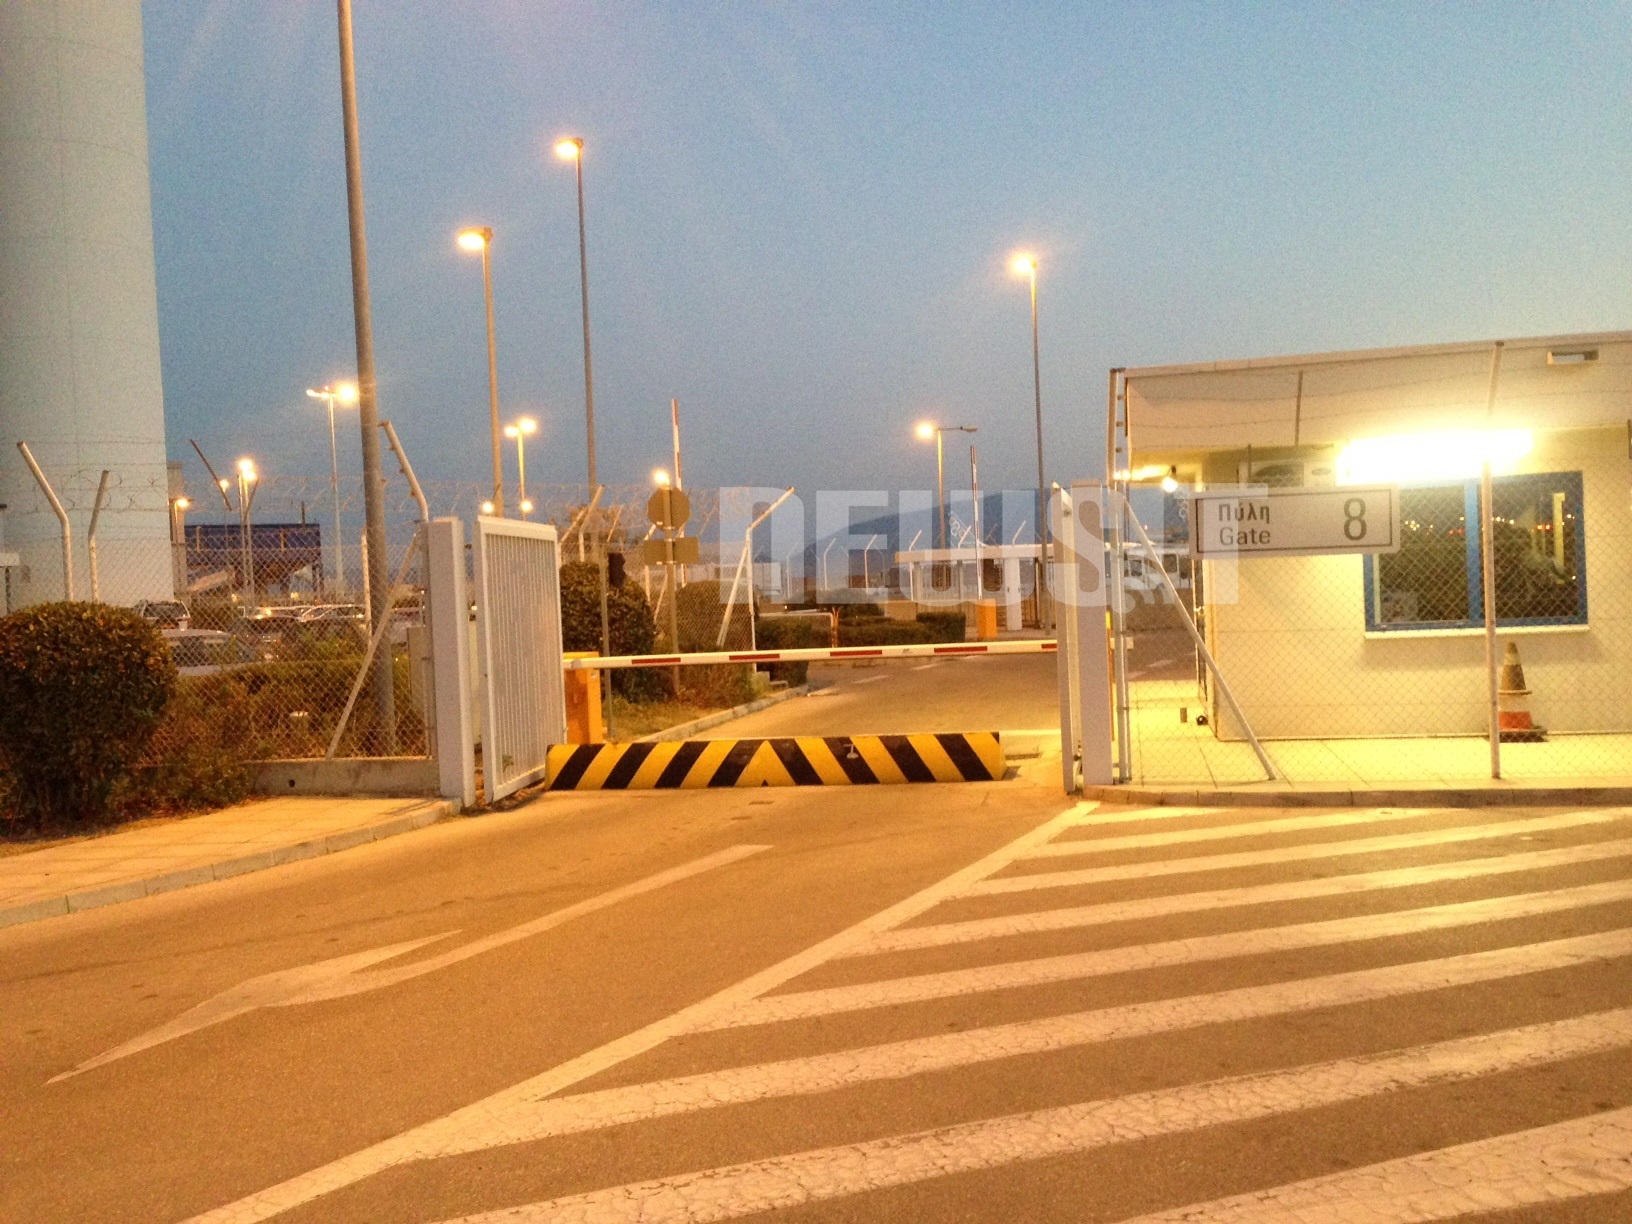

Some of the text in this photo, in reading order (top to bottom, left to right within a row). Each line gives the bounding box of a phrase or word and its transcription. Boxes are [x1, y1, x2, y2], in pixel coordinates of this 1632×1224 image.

[1218, 502, 1270, 525] Πύλη
[1343, 497, 1367, 541] 8
[1219, 526, 1271, 546] Gate
